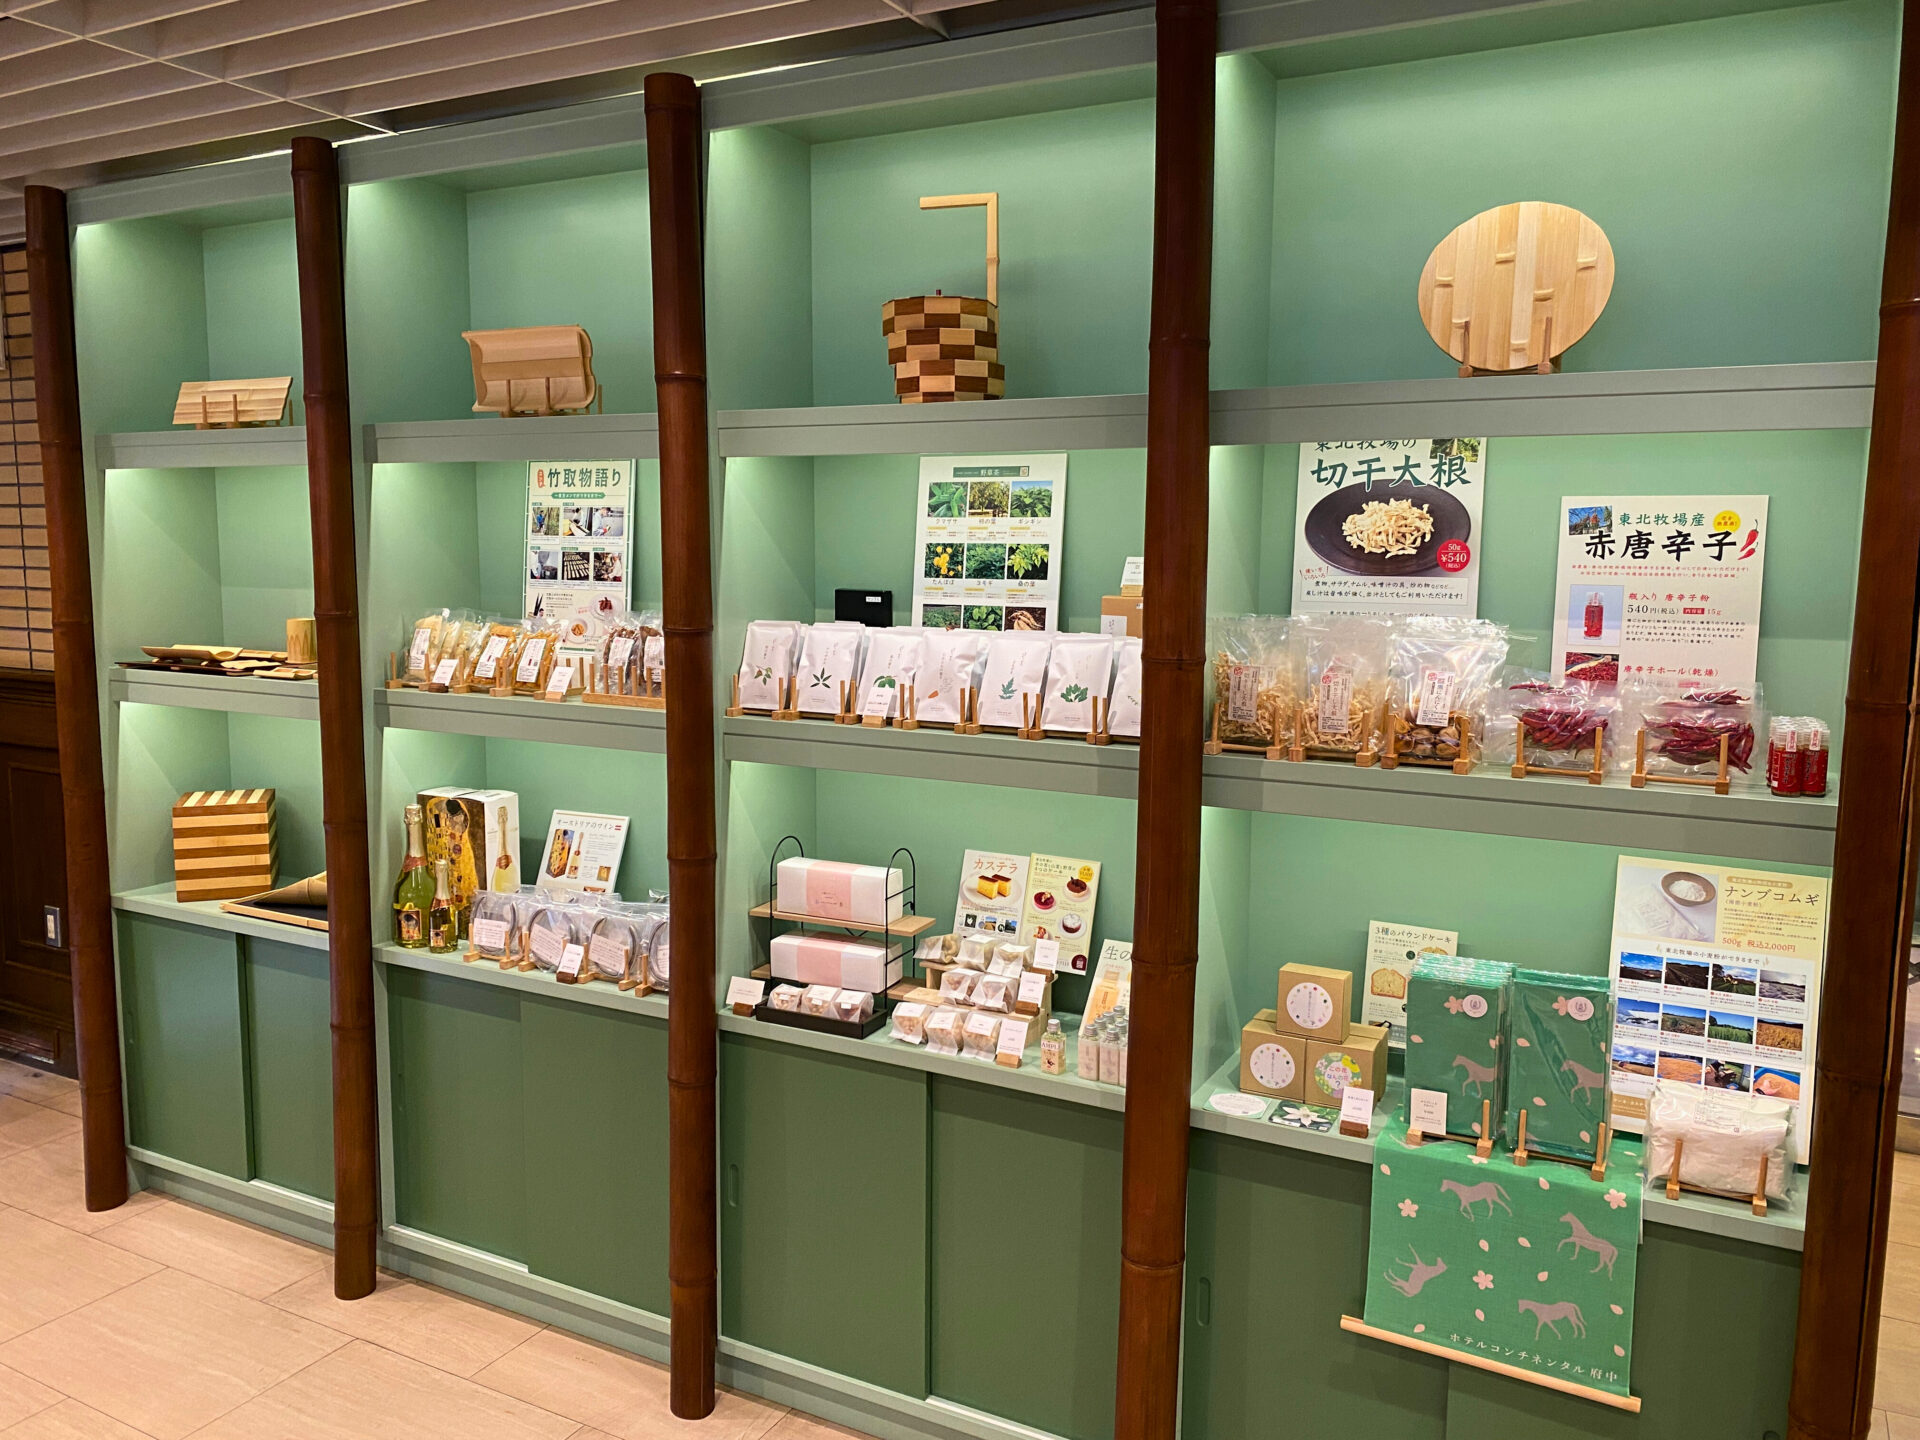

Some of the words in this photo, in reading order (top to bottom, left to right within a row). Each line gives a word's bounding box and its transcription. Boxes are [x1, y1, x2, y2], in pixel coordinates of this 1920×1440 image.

[547, 467, 622, 488] 竹取物語り
[1310, 454, 1472, 492] 切干大根
[1618, 512, 1706, 527] 東北牧場産
[1584, 529, 1738, 562] 赤唐辛子
[1440, 552, 1467, 563] ¥540
[1628, 592, 1657, 601] 瓶入り
[1664, 593, 1710, 602] 唐辛子粉
[1707, 608, 1722, 616] 15g
[1623, 664, 1719, 677] 唐辛子ホール(乾燥)
[975, 859, 1018, 875] カステラ
[1724, 885, 1820, 907] ナンブコムギ
[1375, 926, 1452, 944] 3種のパウンドケーキ
[1722, 937, 1743, 948] 500g
[1747, 939, 1796, 952] 税込2,000円
